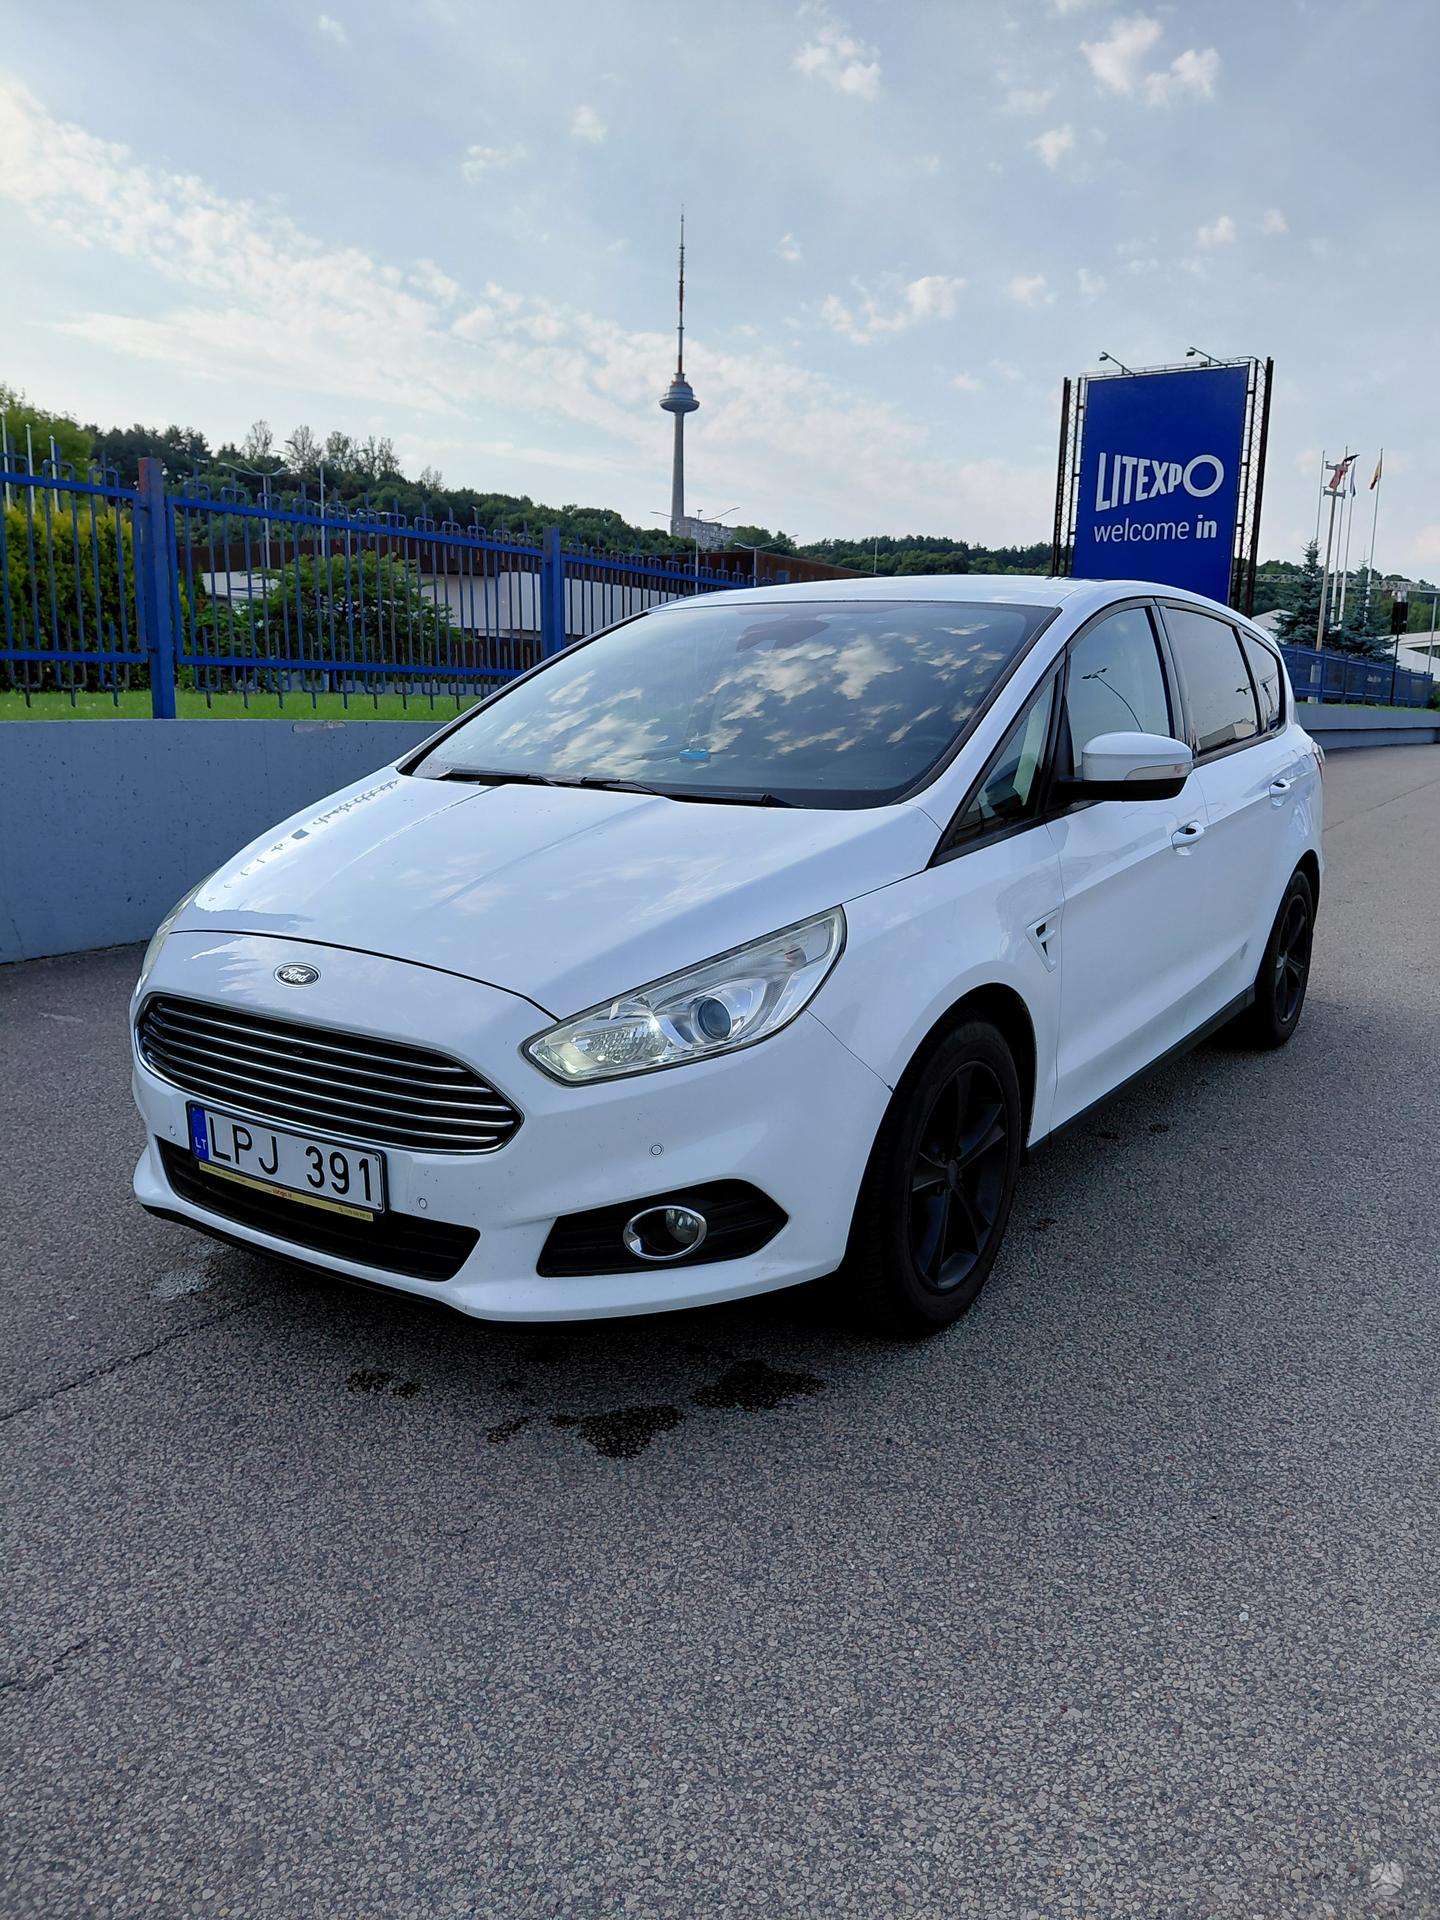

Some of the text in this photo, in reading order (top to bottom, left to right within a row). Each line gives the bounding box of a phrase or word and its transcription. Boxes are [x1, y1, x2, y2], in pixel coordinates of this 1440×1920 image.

[1095, 452, 1225, 512] LITEXPO
[1093, 514, 1218, 543] welcome in
[281, 967, 311, 982] Ford
[194, 1136, 207, 1150] LT
[208, 1116, 372, 1202] LPJ 391
